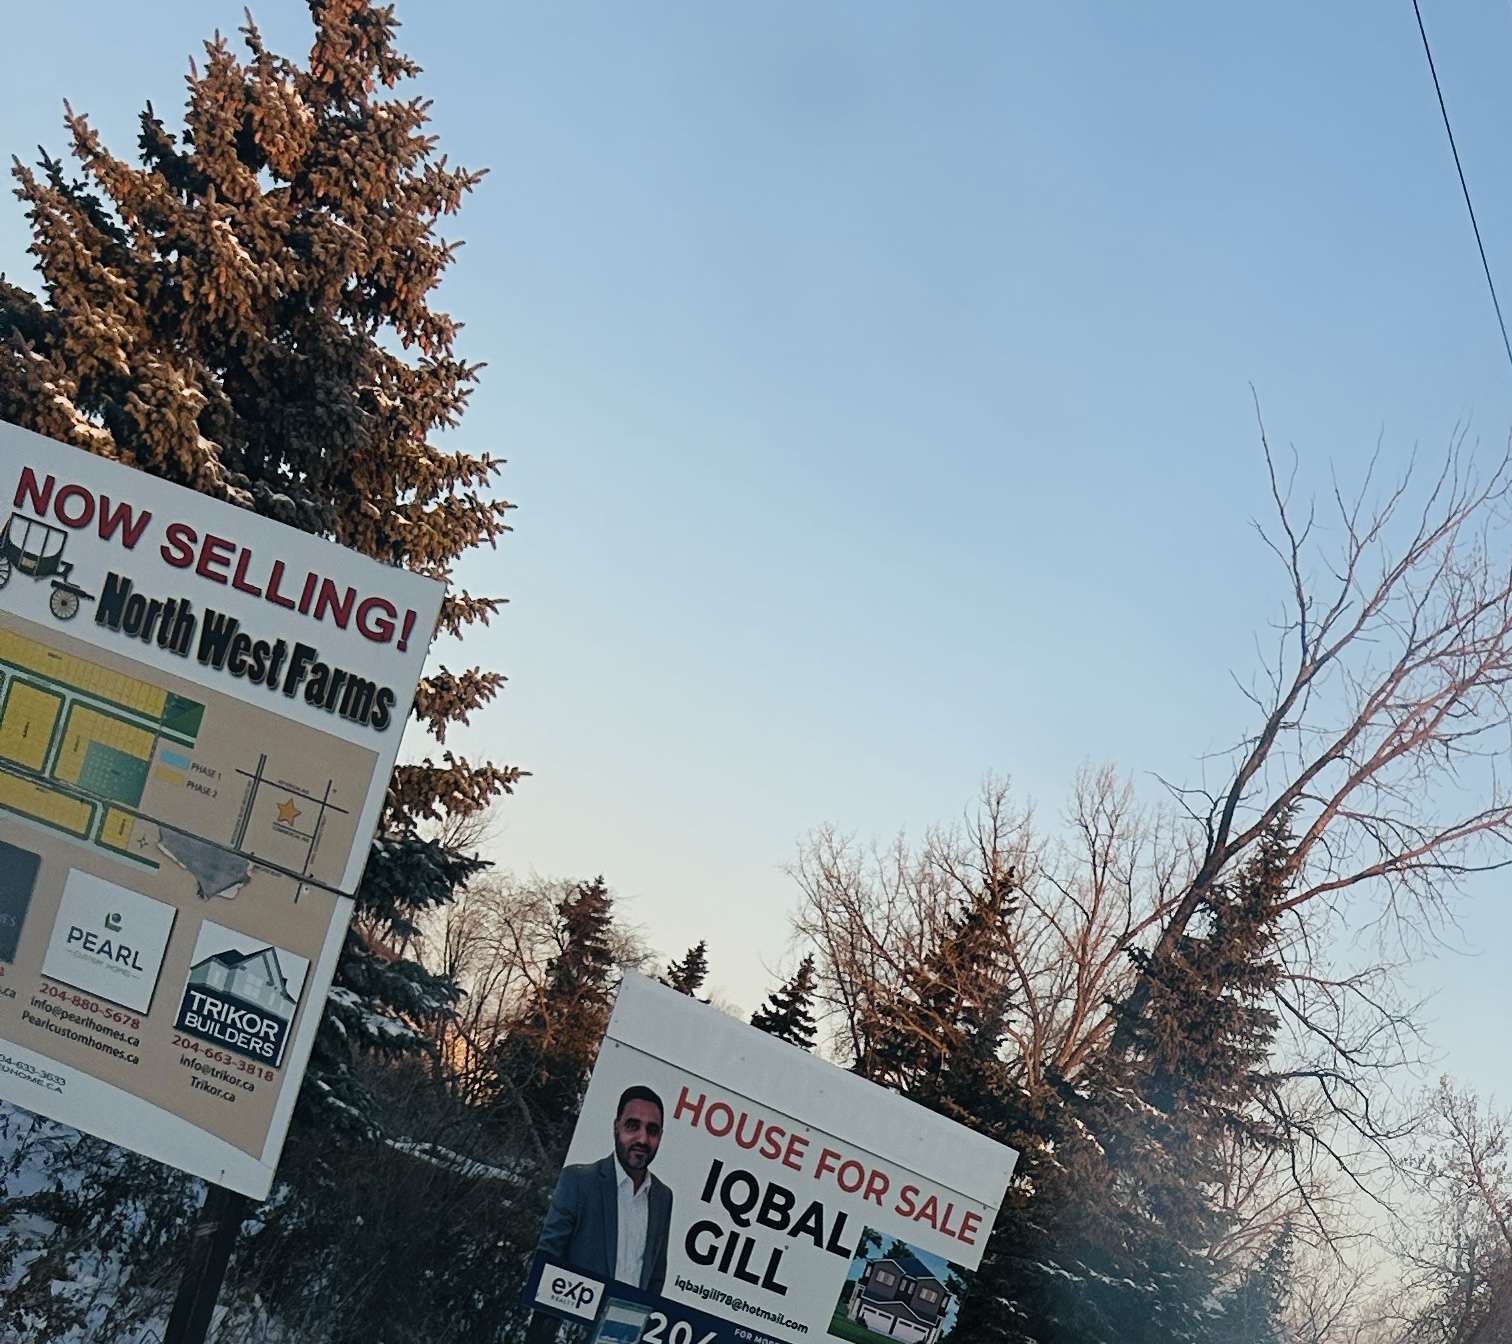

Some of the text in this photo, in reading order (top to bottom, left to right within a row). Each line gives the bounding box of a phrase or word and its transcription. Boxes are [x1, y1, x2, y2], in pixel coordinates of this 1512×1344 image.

[13, 466, 417, 651] NOW SELLING!
[95, 572, 398, 731] North West Farms
[186, 780, 210, 796] PHASE
[191, 761, 216, 778] PHASE
[67, 926, 144, 972] PEARL
[39, 982, 141, 1030] 204-880-5678
[190, 990, 280, 1042] TRIKOR
[21, 1010, 140, 1065] Pearlcustomhomes.ca
[171, 1034, 275, 1083] 204-663-3818
[185, 1013, 276, 1058] BUILDERS
[190, 1075, 237, 1104] Trikor.ca
[673, 1086, 983, 1246] HOUSE FOR SALE
[699, 1159, 852, 1259] IQBAL
[685, 1220, 790, 1296] GILL
[674, 1275, 809, 1335] iqbalgill78@hotmail.com
[734, 1328, 752, 1341] FOR
